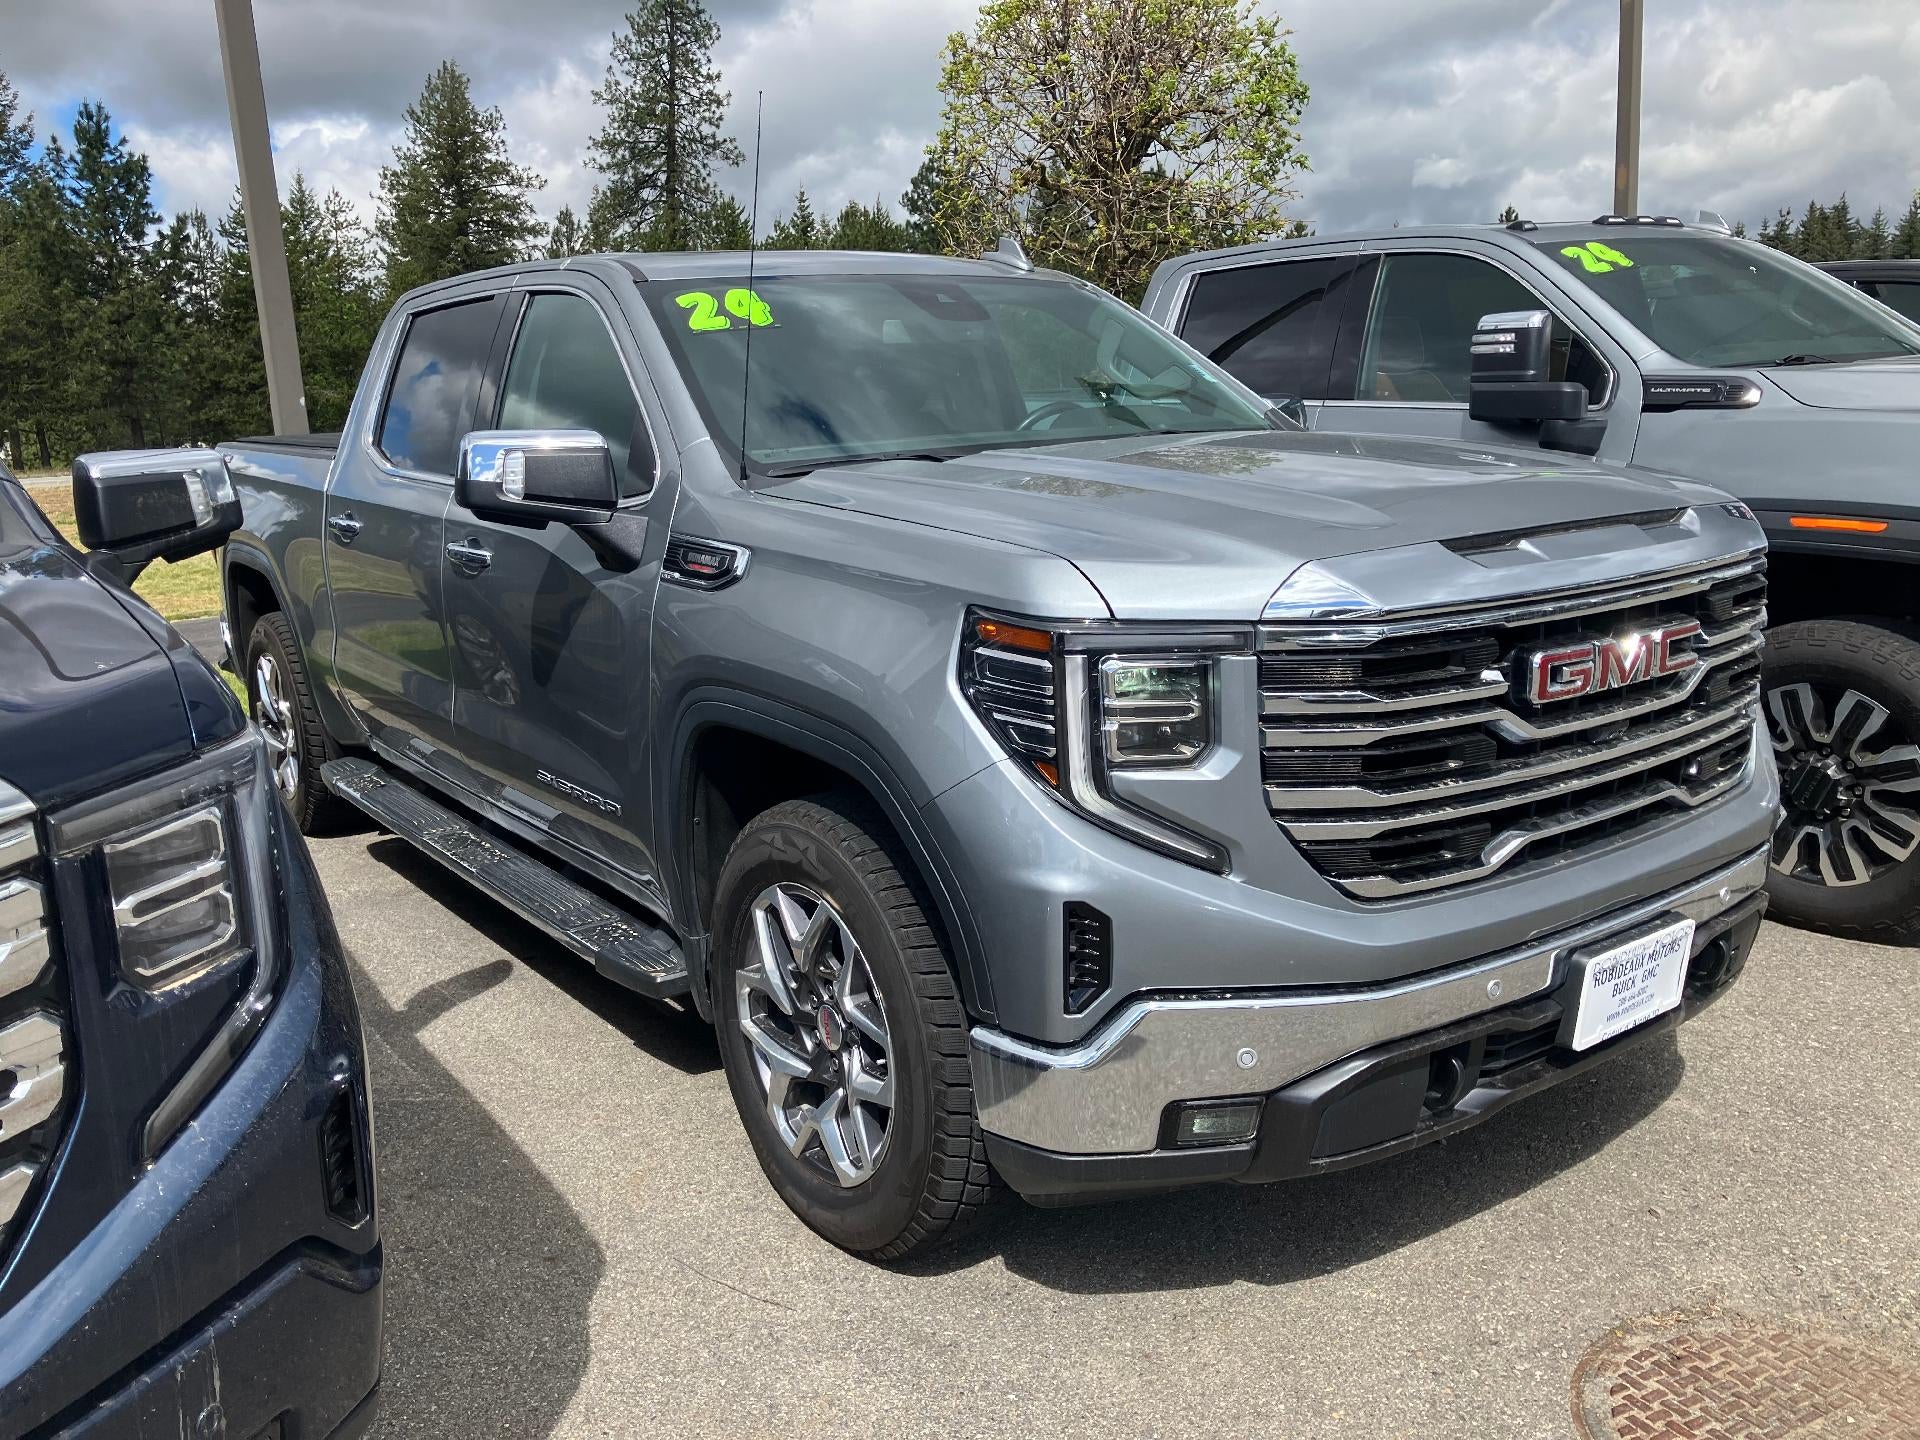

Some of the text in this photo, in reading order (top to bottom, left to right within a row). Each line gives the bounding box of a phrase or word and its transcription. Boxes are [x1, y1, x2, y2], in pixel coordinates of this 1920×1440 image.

[1560, 242, 1634, 273] 24
[675, 288, 774, 331] 24
[1529, 619, 1700, 704] GMC
[536, 769, 622, 817] SIERRA
[1593, 941, 1682, 988] ROBIDEAUX MOTORS
[1612, 964, 1660, 998] BUICK GMC
